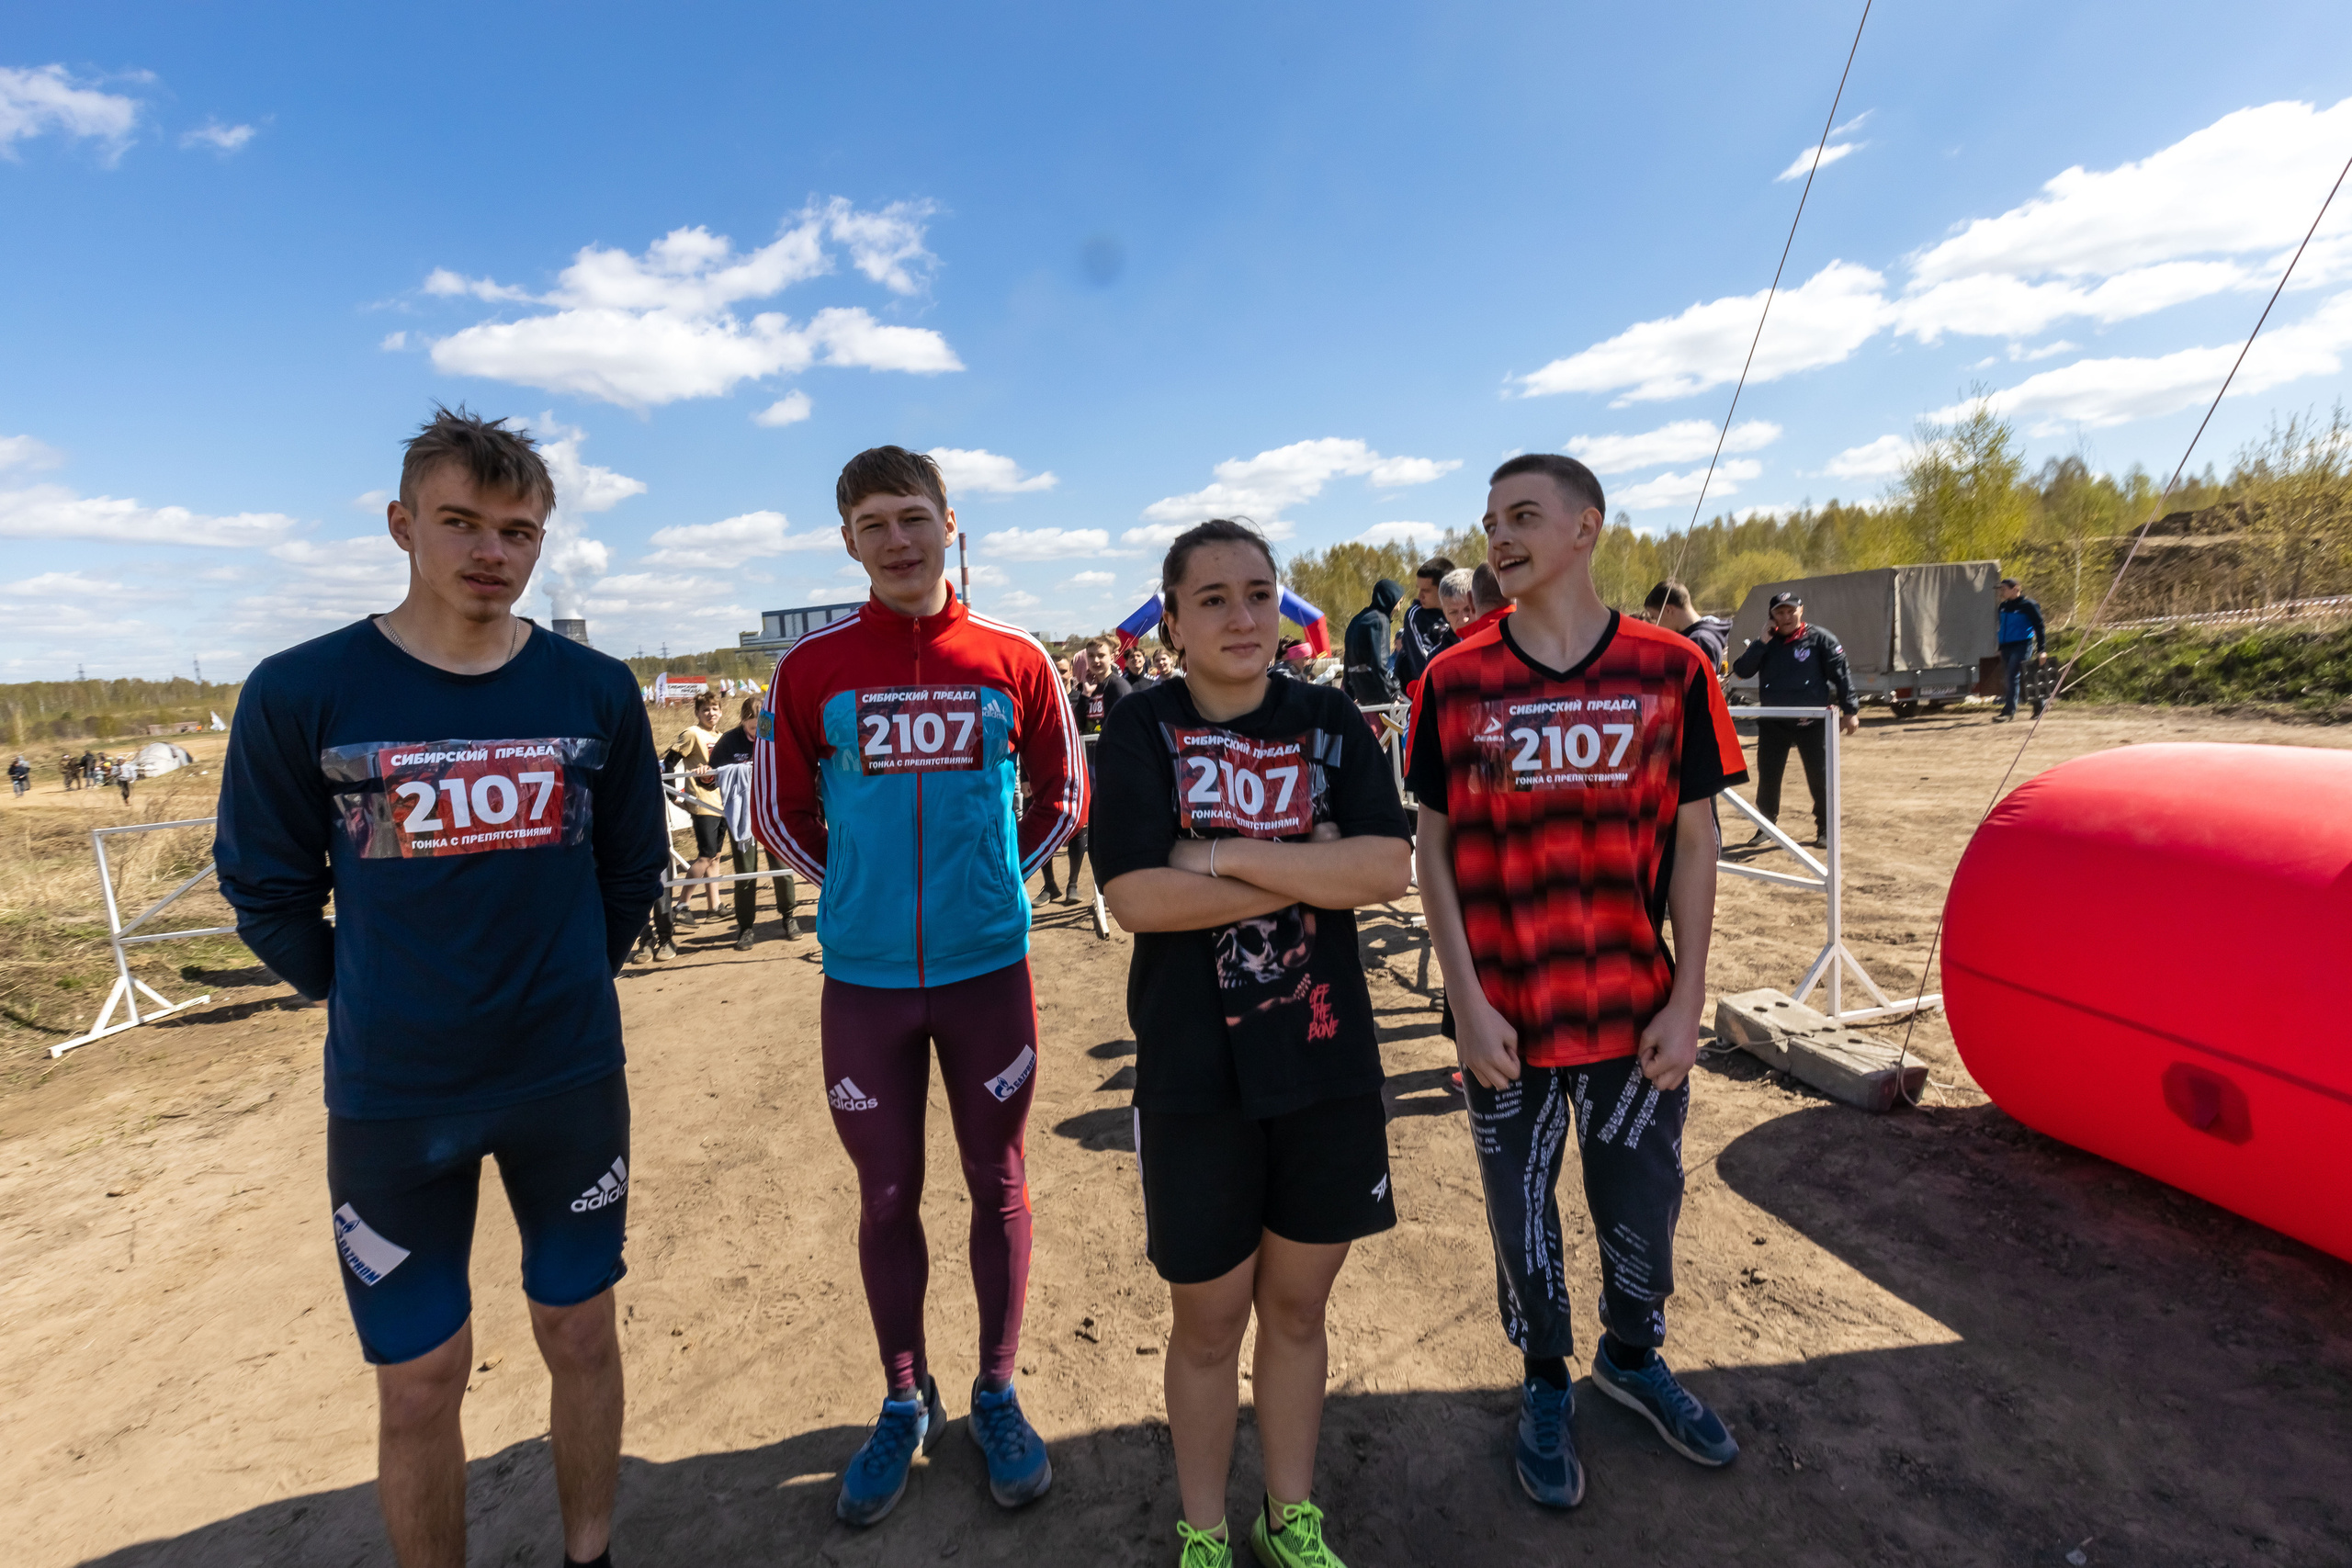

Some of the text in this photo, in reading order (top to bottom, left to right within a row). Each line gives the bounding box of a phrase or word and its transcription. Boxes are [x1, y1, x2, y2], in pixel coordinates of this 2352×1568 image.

[862, 690, 977, 704] СИБИРСКИЙ ПРЕДЕЛ
[1088, 701, 1103, 714] 108
[1509, 699, 1637, 716] СИБИРСКИЙ ПРЕДЕЛ
[863, 712, 976, 756] 2107
[390, 745, 555, 767] СИБИРСКИЙ ПРЕДЕЛ
[1183, 735, 1301, 760] СИБИРСКИЙ ПРЕДЕЛ
[1510, 724, 1634, 772] 2107
[869, 757, 974, 770] ГОНКА С ПРЕПЯТСТВИЯМИ
[1187, 755, 1298, 816] 2107
[1515, 773, 1629, 785] ГОНКА С ПРЕПЯТСТВИЯМИ
[395, 771, 555, 833] 2107
[1191, 809, 1224, 819] ГОНКА
[1225, 811, 1232, 819] С
[411, 826, 553, 851] ГОНКА С ПРЕПЯТСТВИЯМИ
[1307, 1013, 1340, 1042] BONE
[1013, 1054, 1035, 1089] GAZPROM
[829, 1094, 878, 1111] adidas
[571, 1177, 628, 1213] adida
